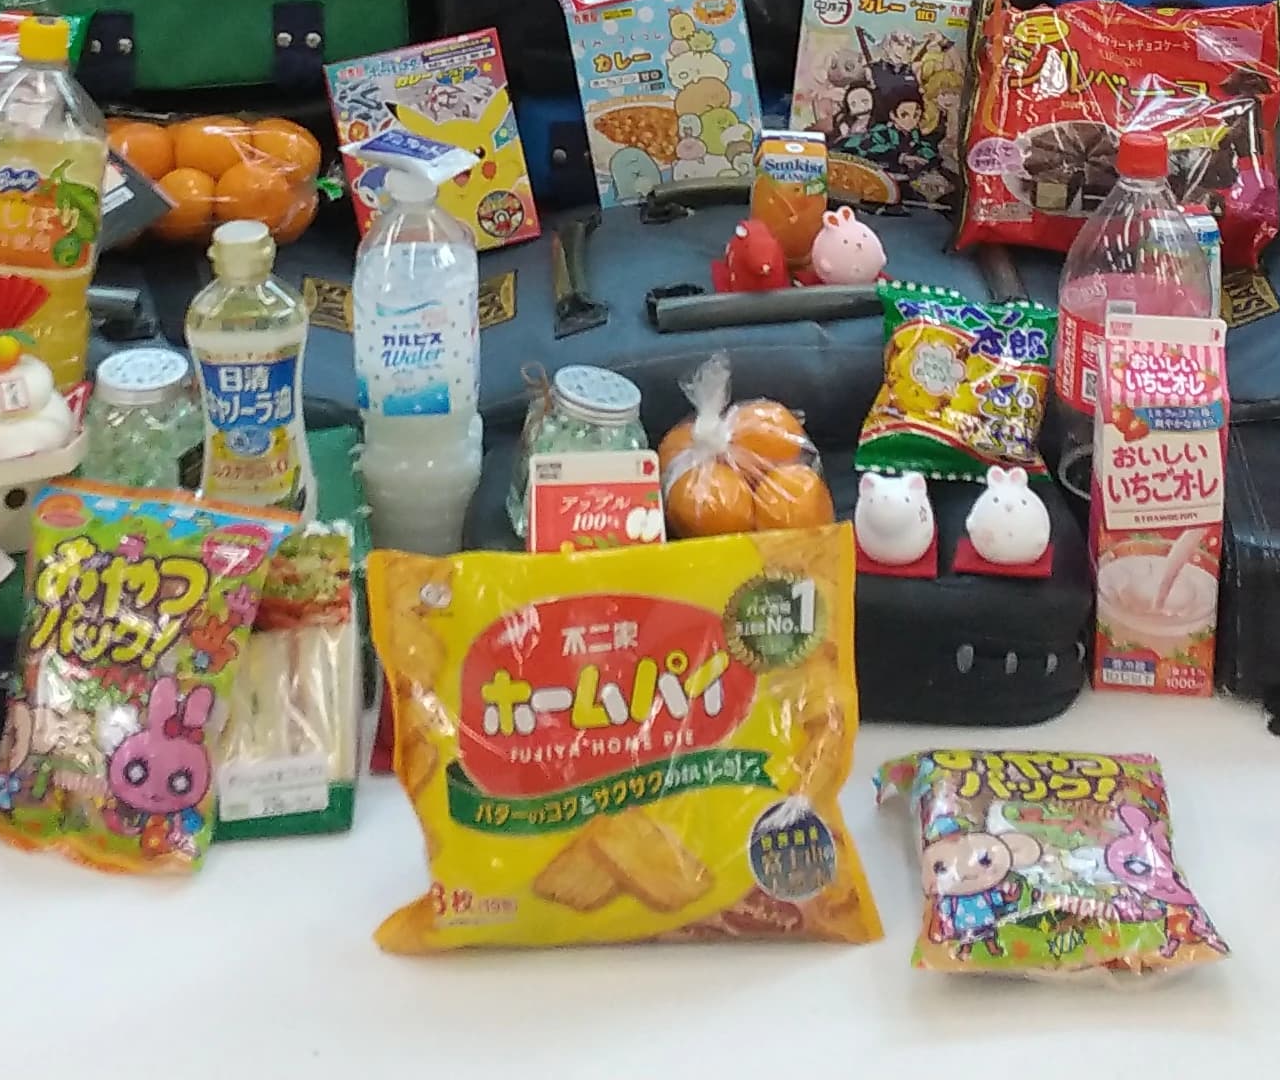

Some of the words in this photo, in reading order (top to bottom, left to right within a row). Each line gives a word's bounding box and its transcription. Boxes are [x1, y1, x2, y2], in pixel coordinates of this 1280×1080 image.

[592, 51, 652, 74] カレー
[394, 73, 434, 90] カレー
[764, 158, 825, 175] Sunkist
[381, 332, 444, 348] カルピス
[381, 348, 445, 368] Water
[1130, 352, 1200, 371] おいしい
[219, 366, 270, 393] 日清
[1112, 443, 1209, 469] おいしい
[560, 494, 632, 515] アップル
[572, 512, 620, 532] 100%
[36, 535, 210, 616] おやつ
[560, 620, 639, 658] 不二家
[481, 649, 730, 738] ホームパイ
